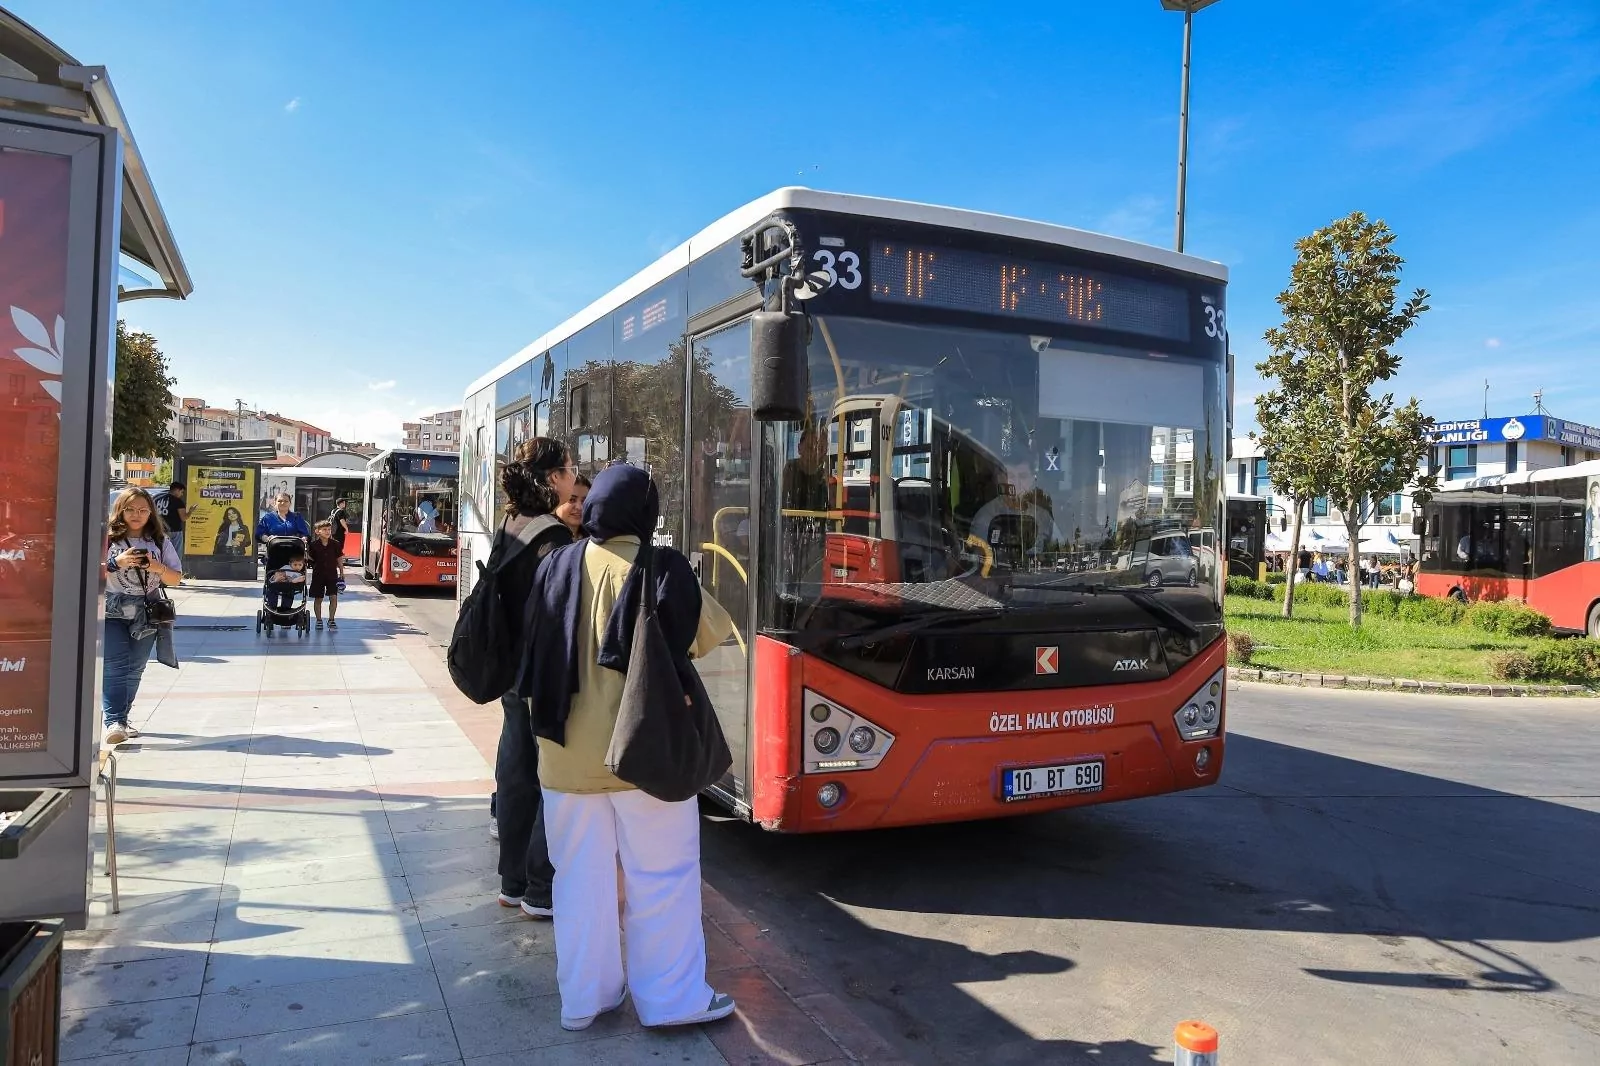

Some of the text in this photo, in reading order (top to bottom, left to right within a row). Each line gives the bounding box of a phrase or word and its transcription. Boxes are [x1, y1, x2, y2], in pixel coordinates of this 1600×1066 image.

[813, 249, 862, 290] 33
[1204, 305, 1226, 342] 33
[202, 489, 241, 499] Dünyaya
[927, 666, 976, 682] KARSAN
[1111, 658, 1149, 672] ATAK
[989, 704, 1116, 733] ÖZEL HALK OTOBÜSÜ
[14, 732, 44, 742] No:8/3
[1015, 764, 1101, 792] 10 BT 690
